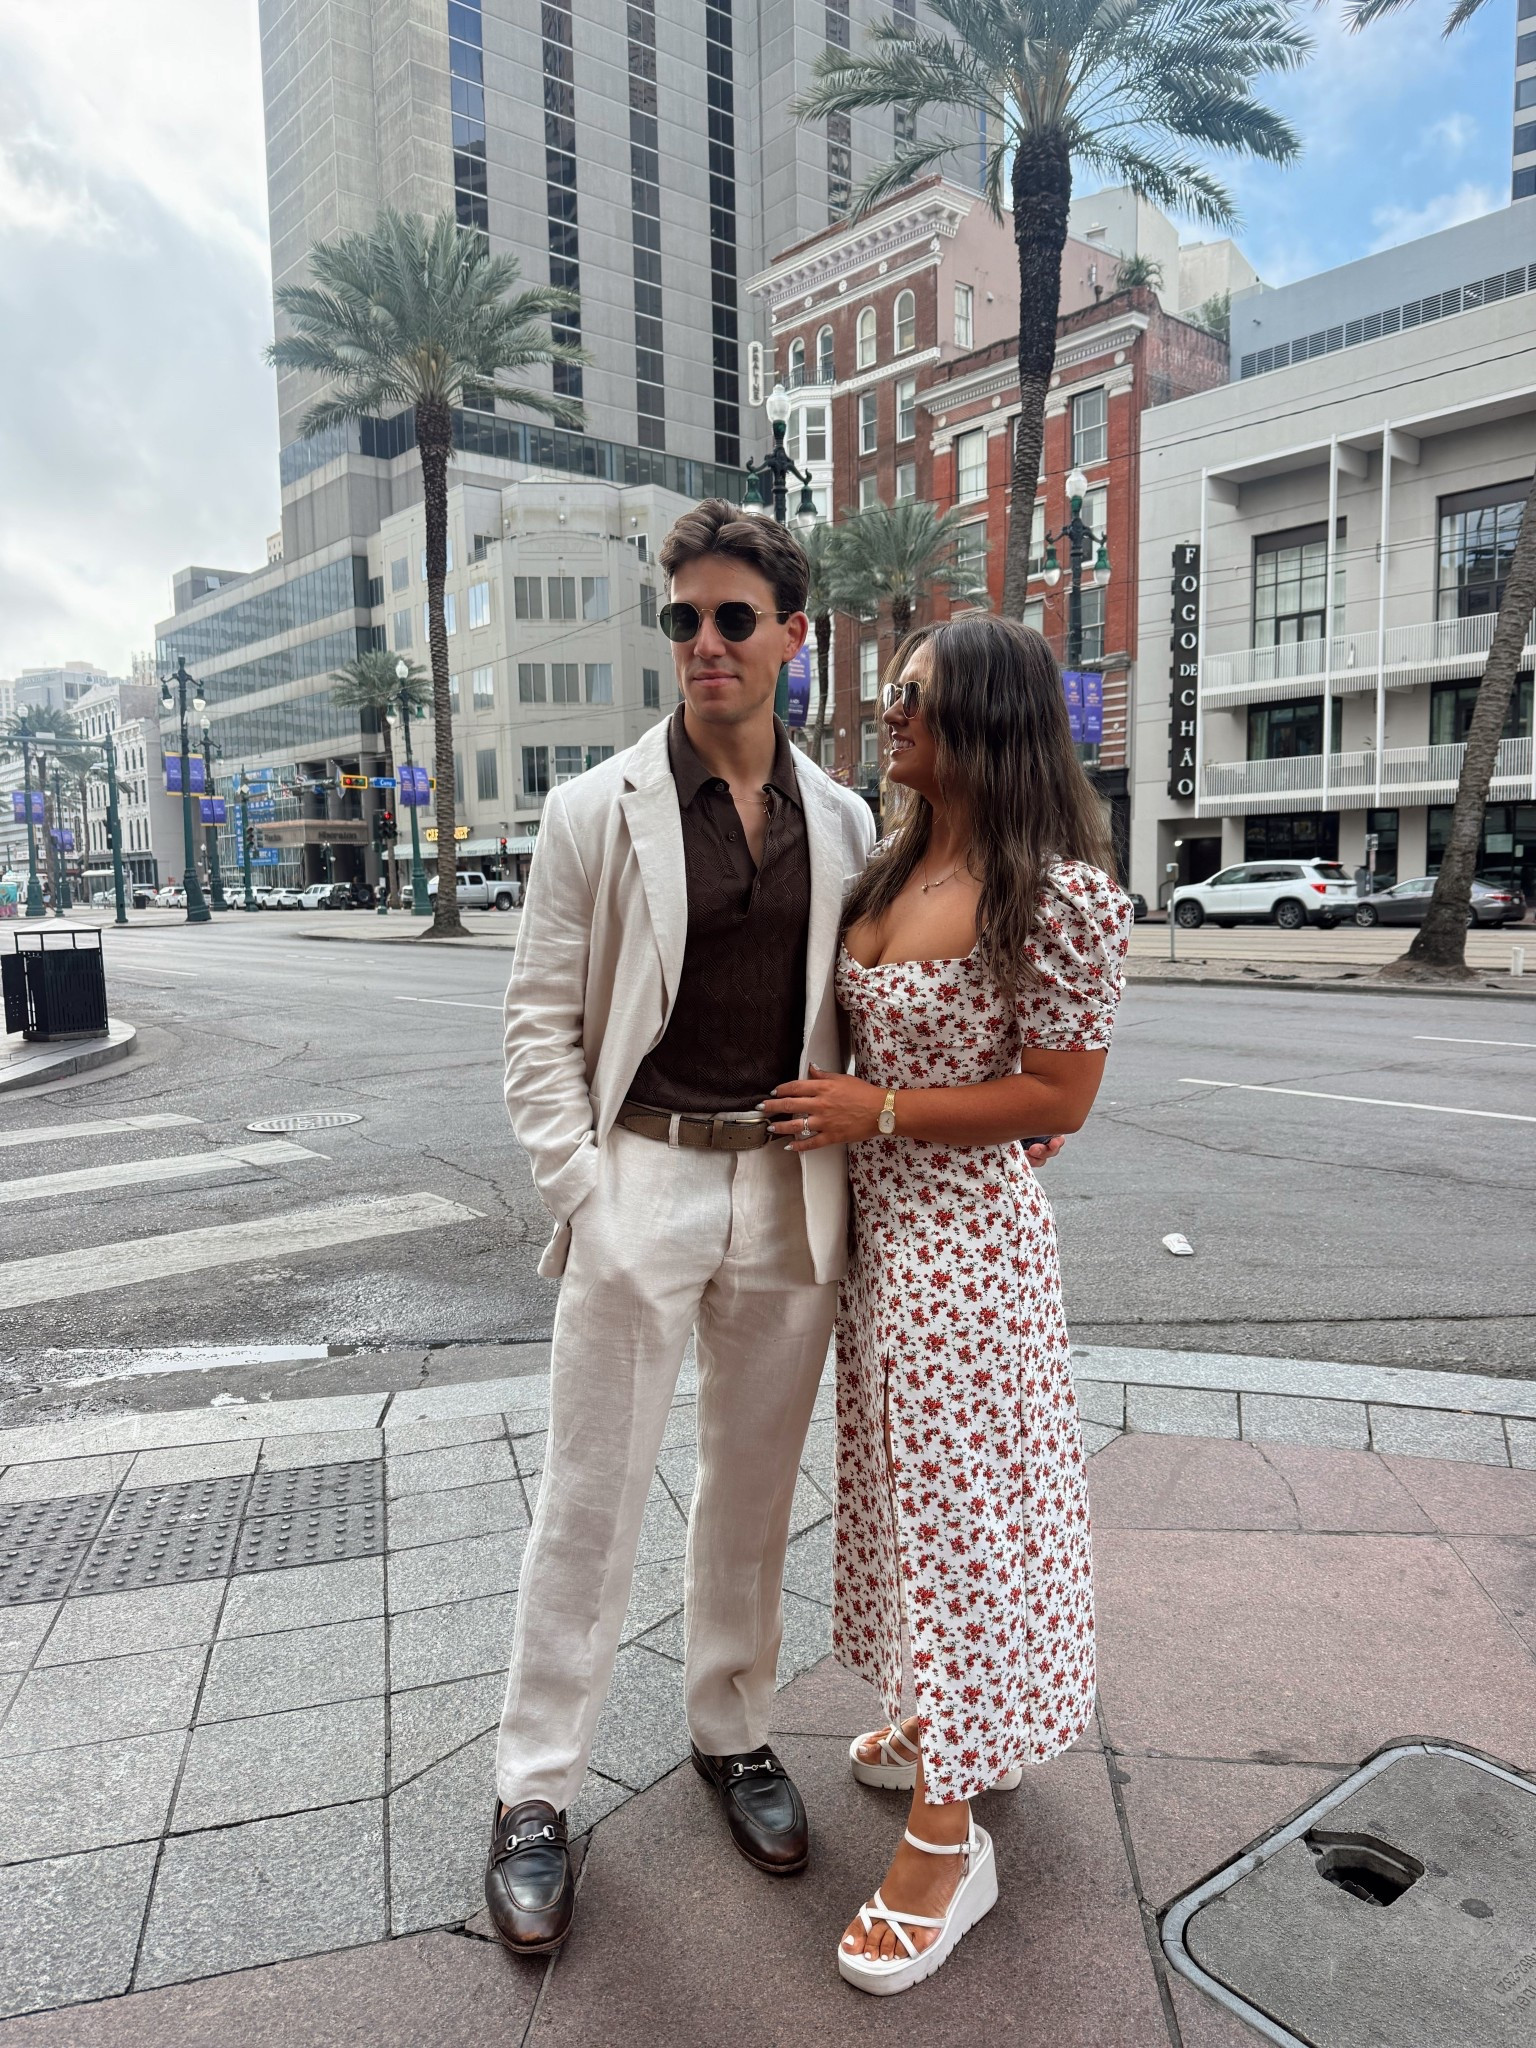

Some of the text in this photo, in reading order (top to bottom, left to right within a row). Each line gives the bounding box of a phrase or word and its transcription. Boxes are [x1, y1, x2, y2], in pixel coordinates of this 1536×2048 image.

[752, 346, 760, 400] PRALINE
[1177, 547, 1198, 796] FOGO DE CHÃO
